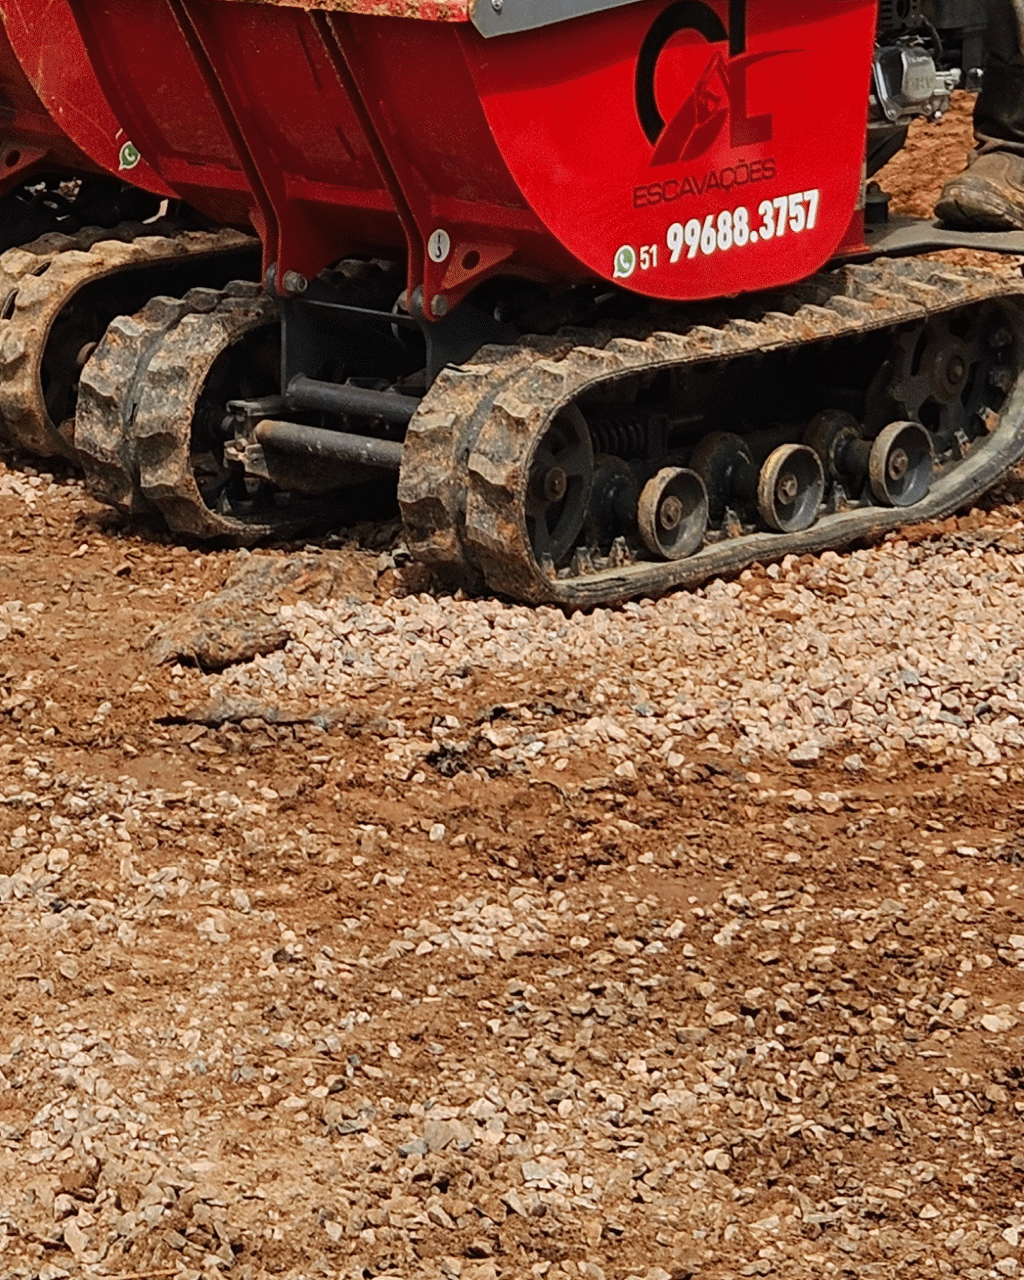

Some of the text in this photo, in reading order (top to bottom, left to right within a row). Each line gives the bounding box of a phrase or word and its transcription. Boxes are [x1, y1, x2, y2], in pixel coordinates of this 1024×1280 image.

[632, 158, 776, 209] ESCAVAÇÕES
[639, 188, 820, 270] 51 99688.3757
